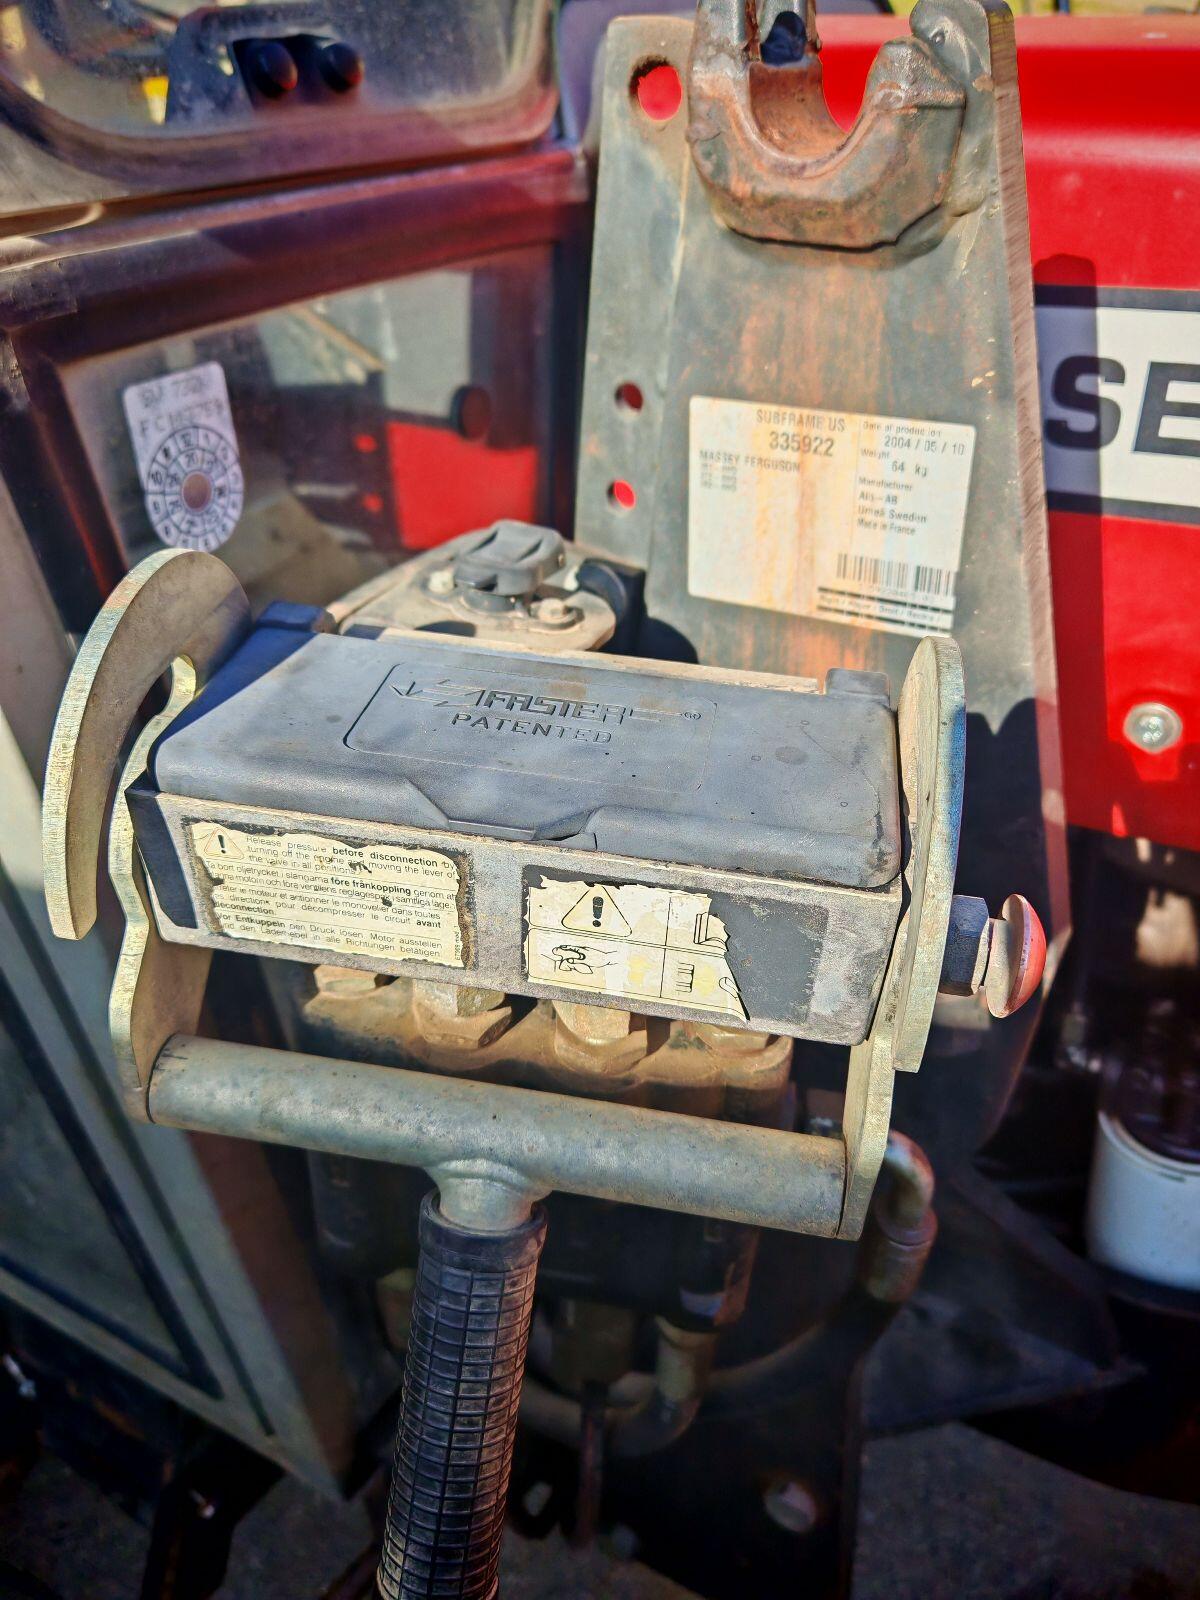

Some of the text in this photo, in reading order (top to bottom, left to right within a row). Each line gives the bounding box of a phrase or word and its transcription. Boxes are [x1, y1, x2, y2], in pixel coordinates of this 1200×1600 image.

[756, 409, 846, 433] SUBFRAME US
[769, 431, 835, 457] 335922
[884, 435, 911, 450] 2004
[924, 441, 937, 453] 05
[952, 444, 965, 456] 10
[744, 455, 801, 473] FERGUSON
[891, 461, 928, 478] 64 kg
[857, 518, 916, 535] Made in France
[889, 509, 927, 523] Sweden
[484, 690, 626, 725] FASTER
[451, 712, 613, 744] PATENTED
[246, 836, 281, 847] Release
[287, 842, 327, 853] pressure
[333, 847, 364, 857] before
[370, 852, 438, 867] disconnection
[247, 845, 278, 857] turning
[296, 852, 310, 860] the
[313, 854, 344, 865] engine
[368, 862, 402, 873] moving
[404, 865, 419, 874] the
[422, 867, 444, 878] lever
[248, 855, 262, 863] the
[267, 858, 288, 866] valve
[206, 861, 215, 869] Ta
[217, 861, 235, 871] bort
[237, 865, 279, 877] oljetrycket
[286, 872, 329, 884] slangarna
[352, 879, 411, 896] frånkoppling
[413, 889, 444, 898] genom
[235, 875, 265, 885] motorn
[266, 879, 281, 887] och
[395, 896, 430, 907] samtliga
[249, 889, 277, 898] moteur
[289, 894, 329, 905] actionner
[392, 907, 413, 916] dans
[415, 910, 441, 920] toutes
[275, 901, 295, 910] pour
[384, 915, 411, 925] circuit
[416, 919, 441, 929] avant
[235, 914, 286, 928] Entkuppeln
[310, 924, 335, 934] Druck
[370, 932, 395, 943] Motor
[399, 938, 443, 949] ausstellen
[240, 924, 256, 932] den
[326, 935, 340, 943] alle
[346, 938, 395, 951] Richtungen
